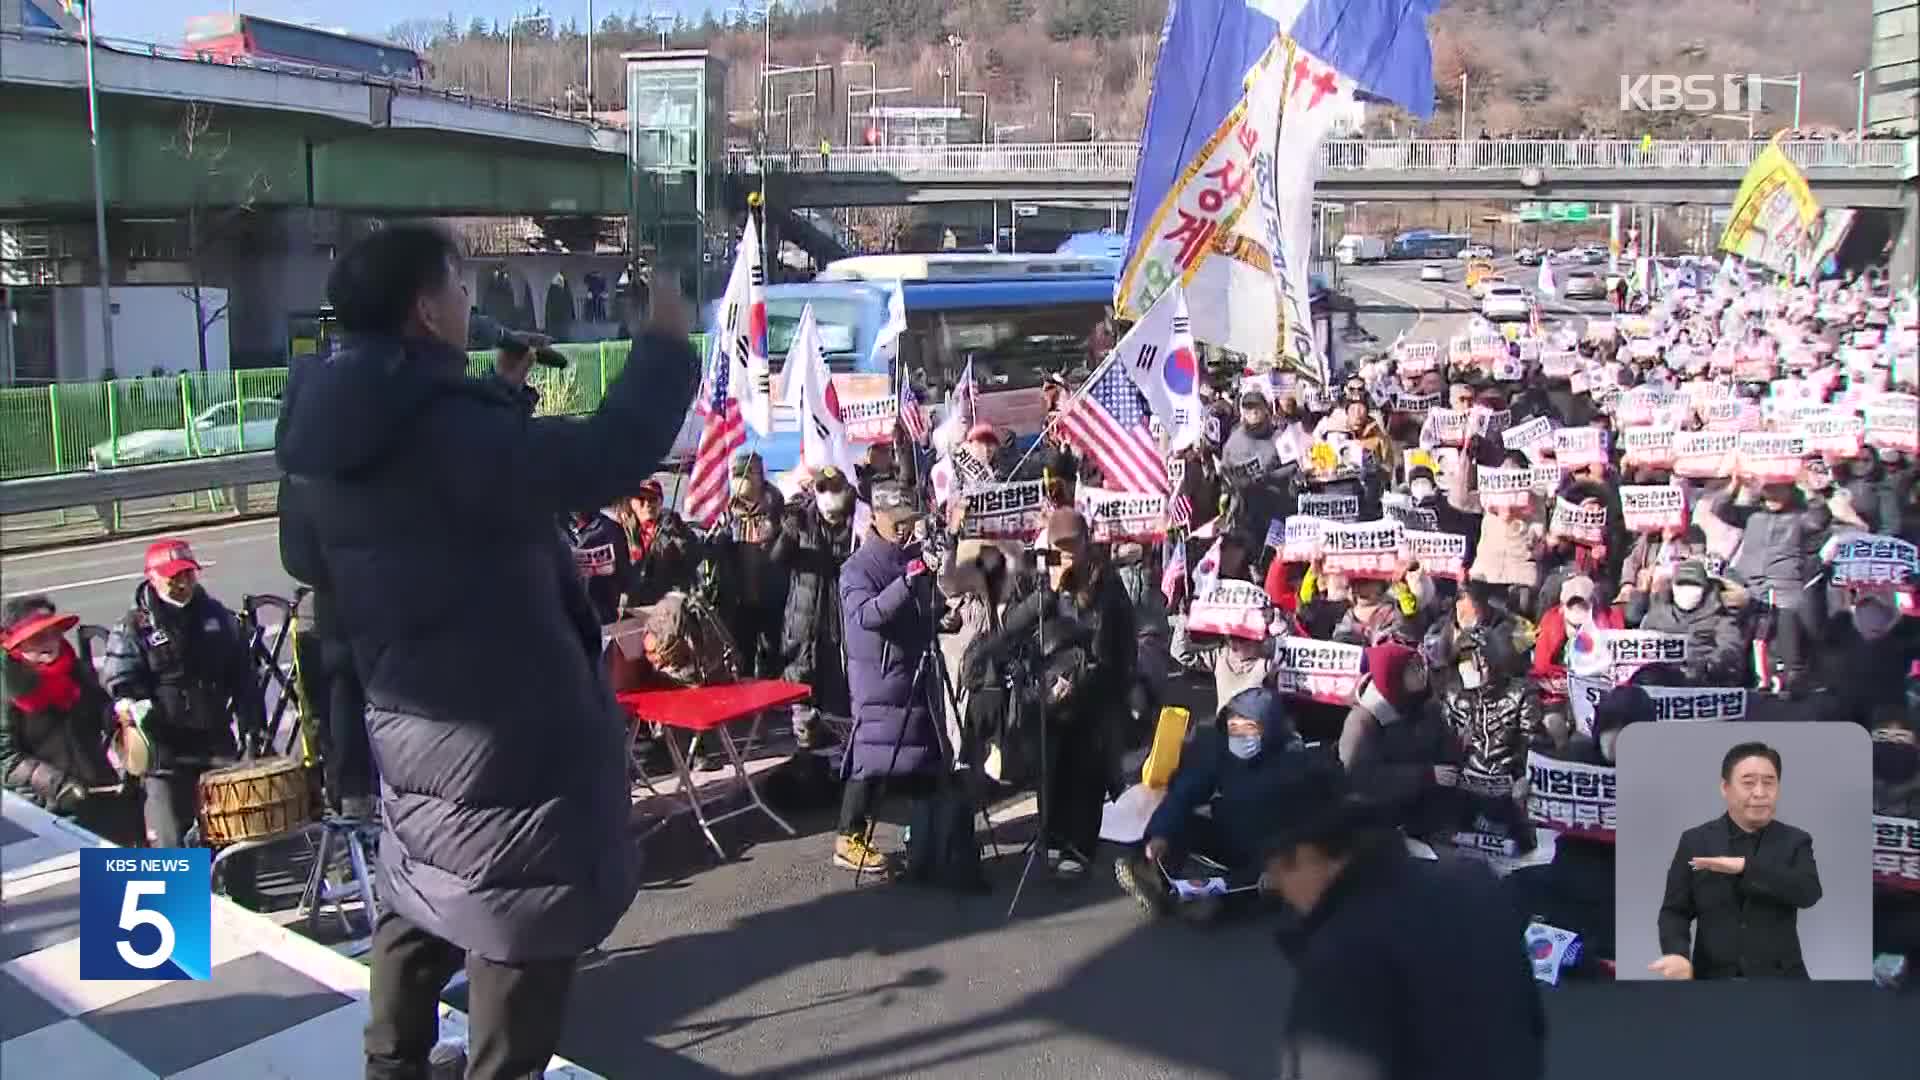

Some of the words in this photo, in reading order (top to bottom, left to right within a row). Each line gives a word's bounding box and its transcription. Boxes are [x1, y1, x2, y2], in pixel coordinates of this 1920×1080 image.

[966, 484, 1040, 514] 계엄합법
[1324, 529, 1395, 551] 계엄합법
[1278, 646, 1359, 671] 계엄합법
